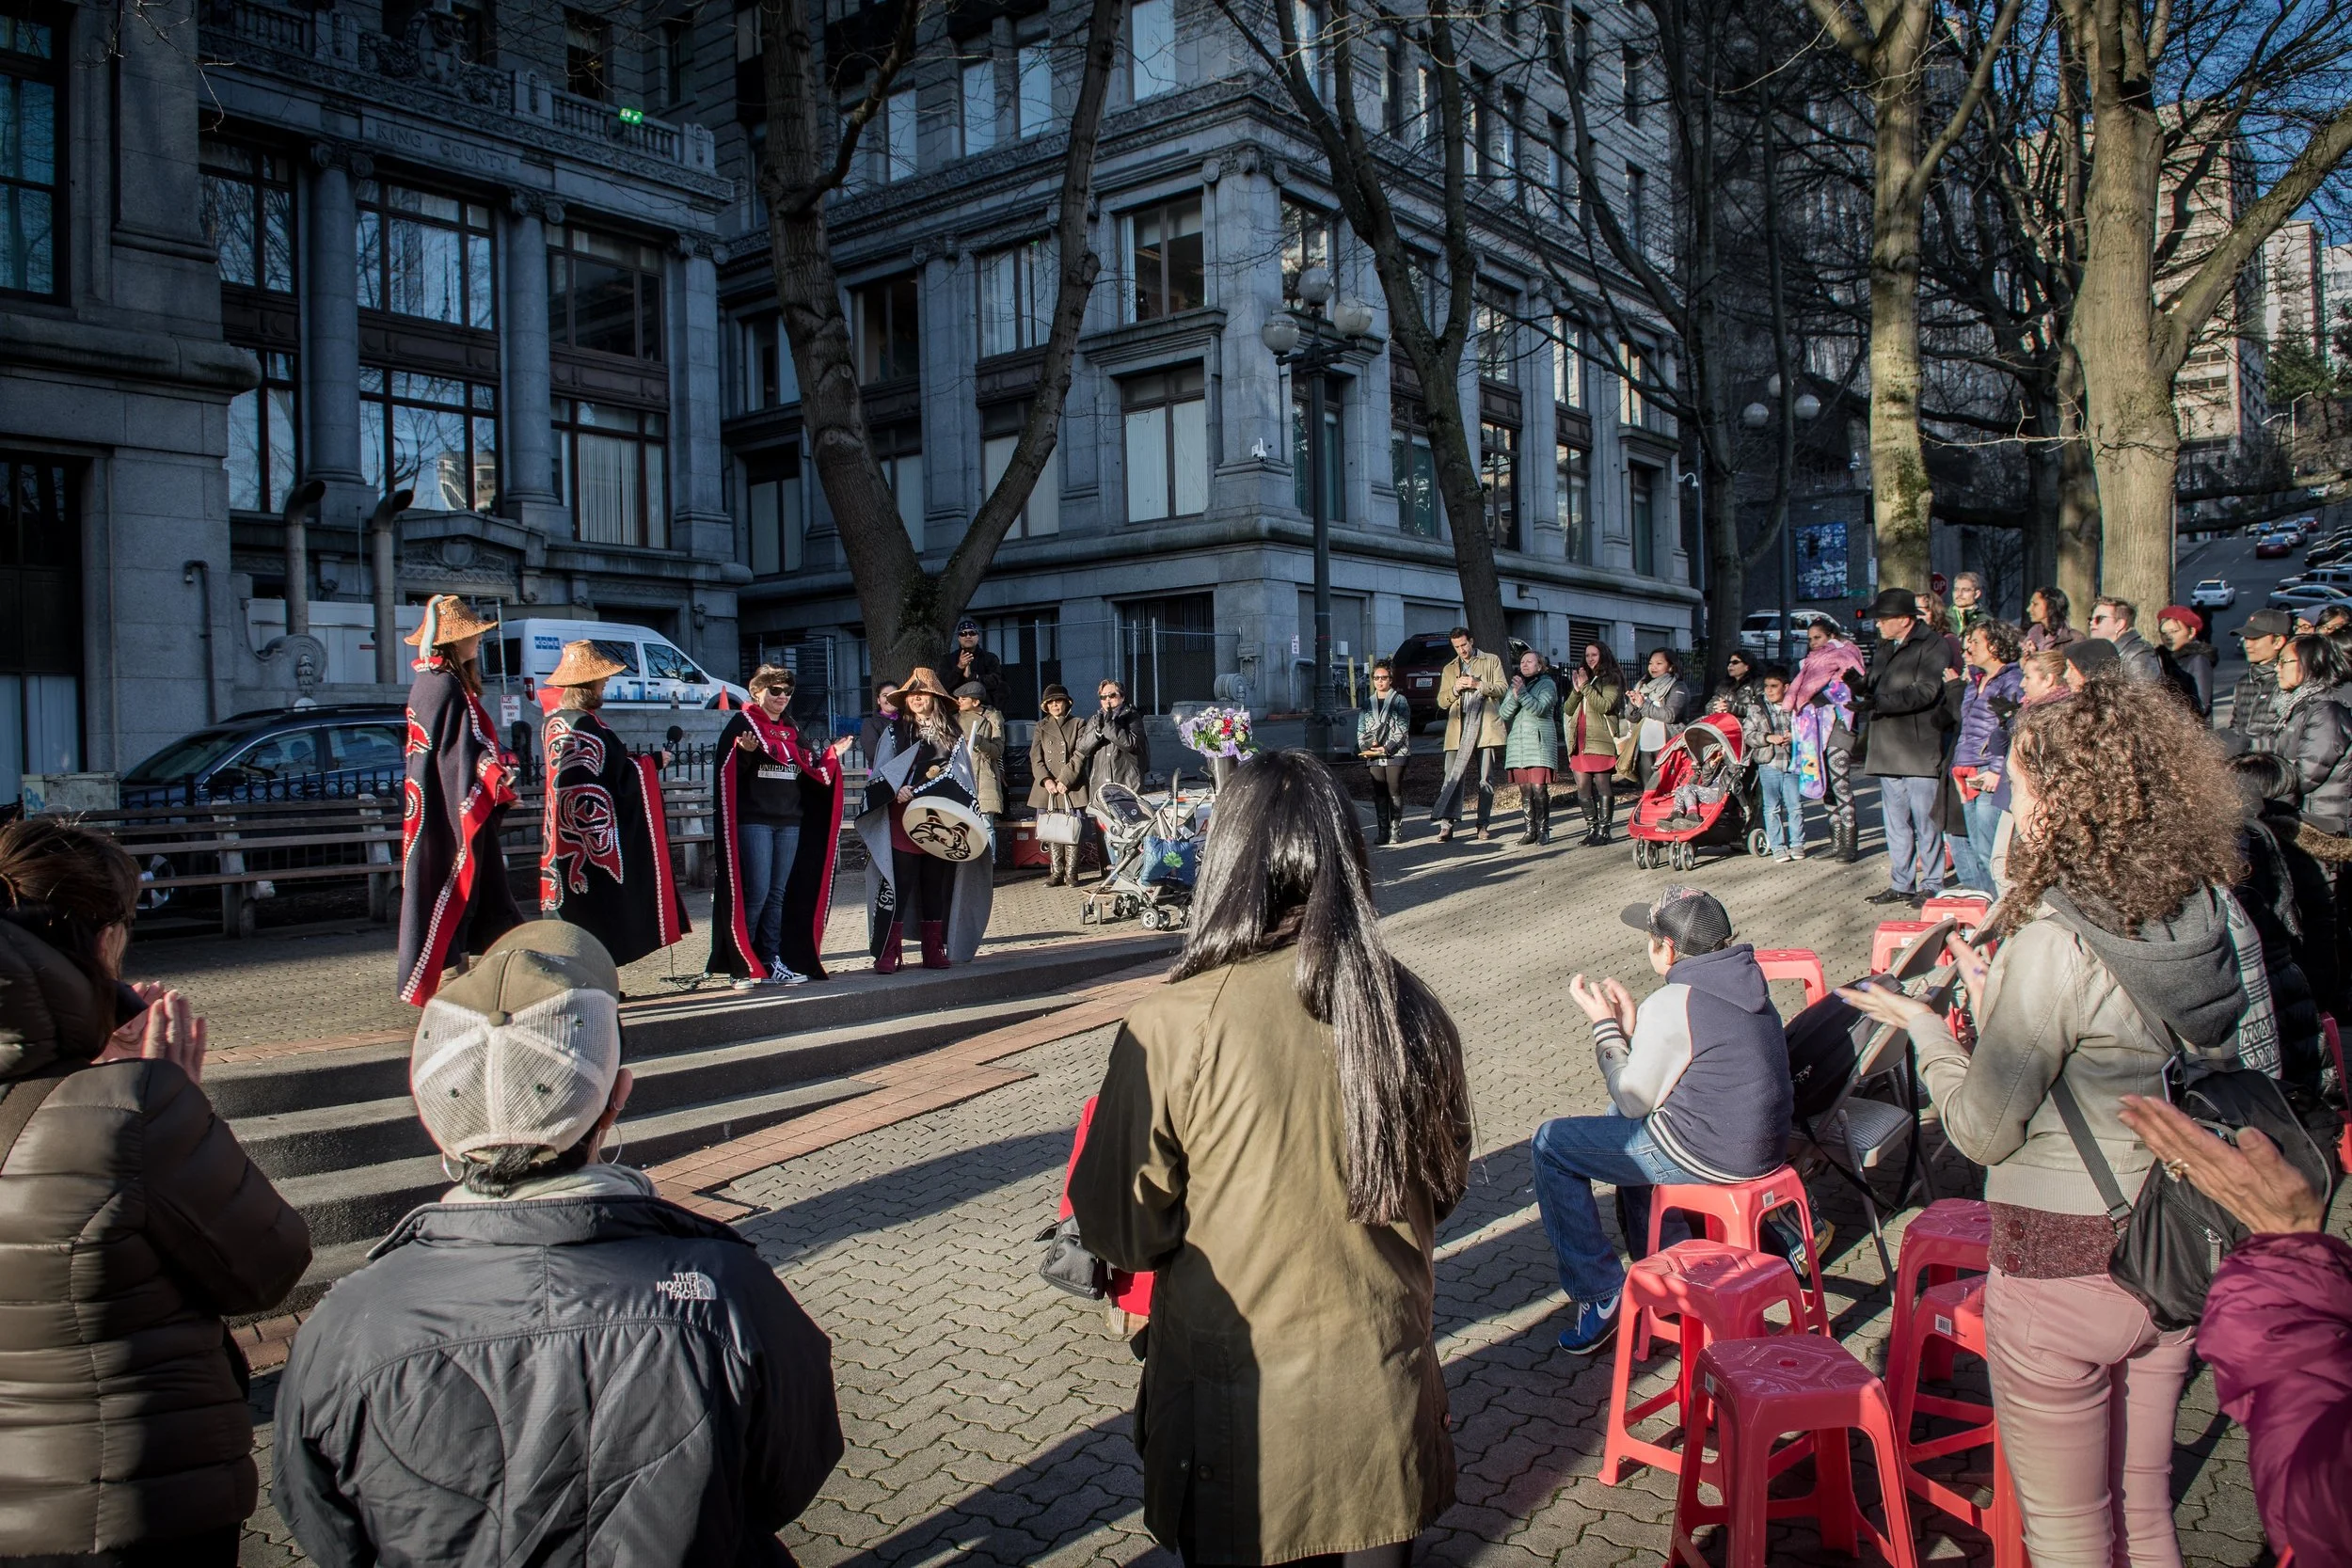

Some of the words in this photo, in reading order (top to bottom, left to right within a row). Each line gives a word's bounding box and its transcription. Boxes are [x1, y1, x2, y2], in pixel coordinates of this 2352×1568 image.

[377, 124, 421, 149] KING
[439, 141, 505, 170] COUNTY
[674, 1273, 696, 1282] THE
[657, 1281, 697, 1291] NORTH
[669, 1291, 697, 1300] FACE
